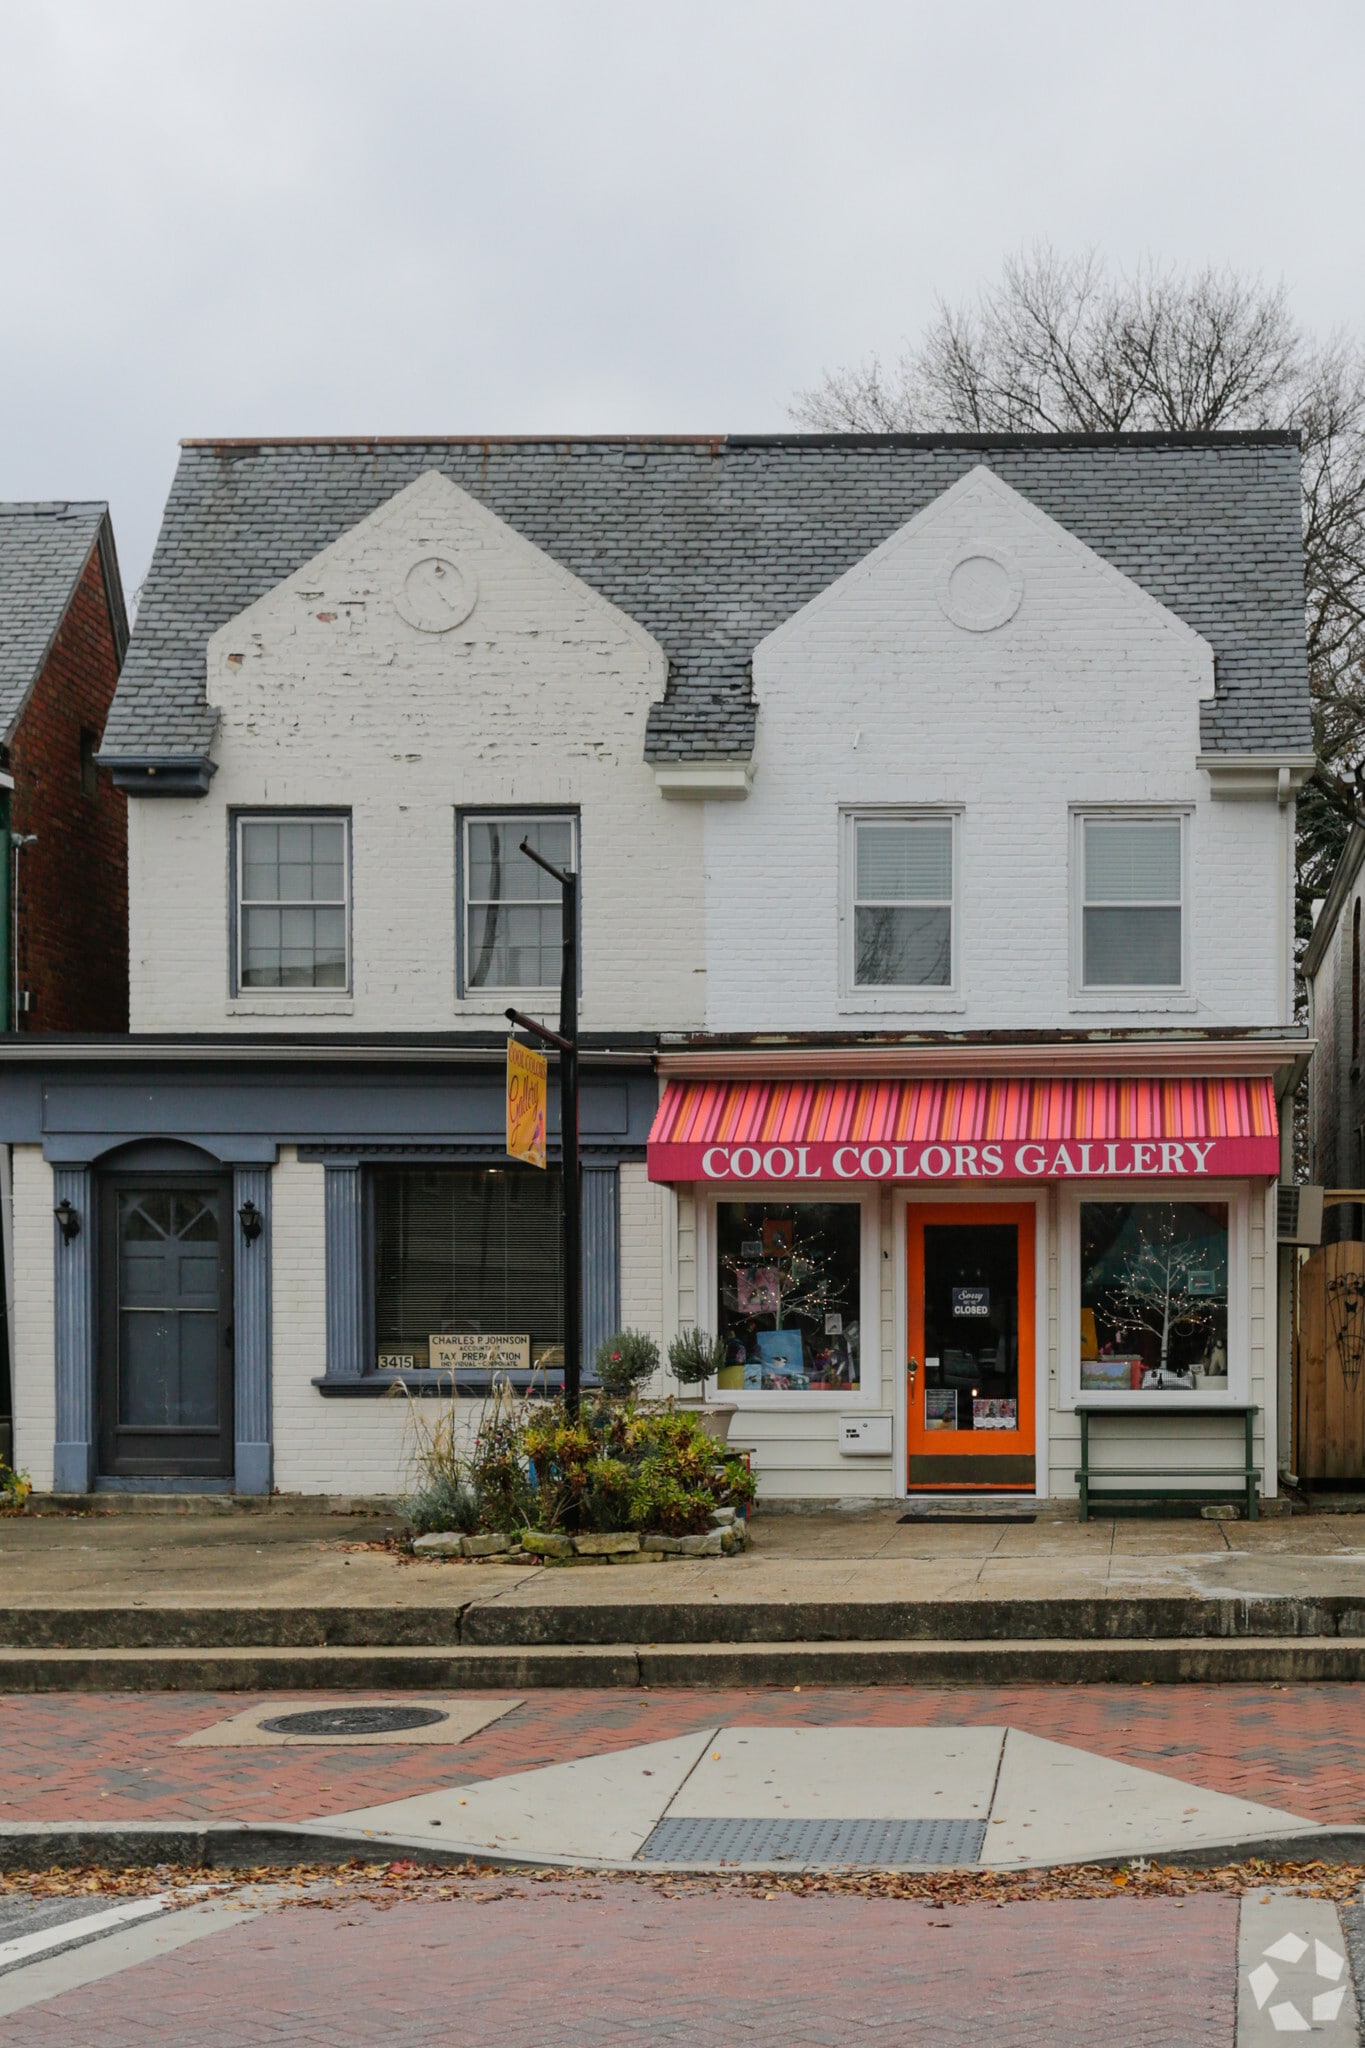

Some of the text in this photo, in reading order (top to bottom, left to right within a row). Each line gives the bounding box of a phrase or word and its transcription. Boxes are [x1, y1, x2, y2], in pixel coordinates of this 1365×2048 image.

[702, 1142, 1216, 1178] COOL COLORS GALLERY
[958, 1290, 983, 1303] Sorry
[954, 1306, 988, 1315] CLOSED
[432, 1336, 474, 1345] CHARLES
[485, 1336, 527, 1345] JOHNSON
[439, 1352, 457, 1361] TAX
[380, 1356, 412, 1368] 3415
